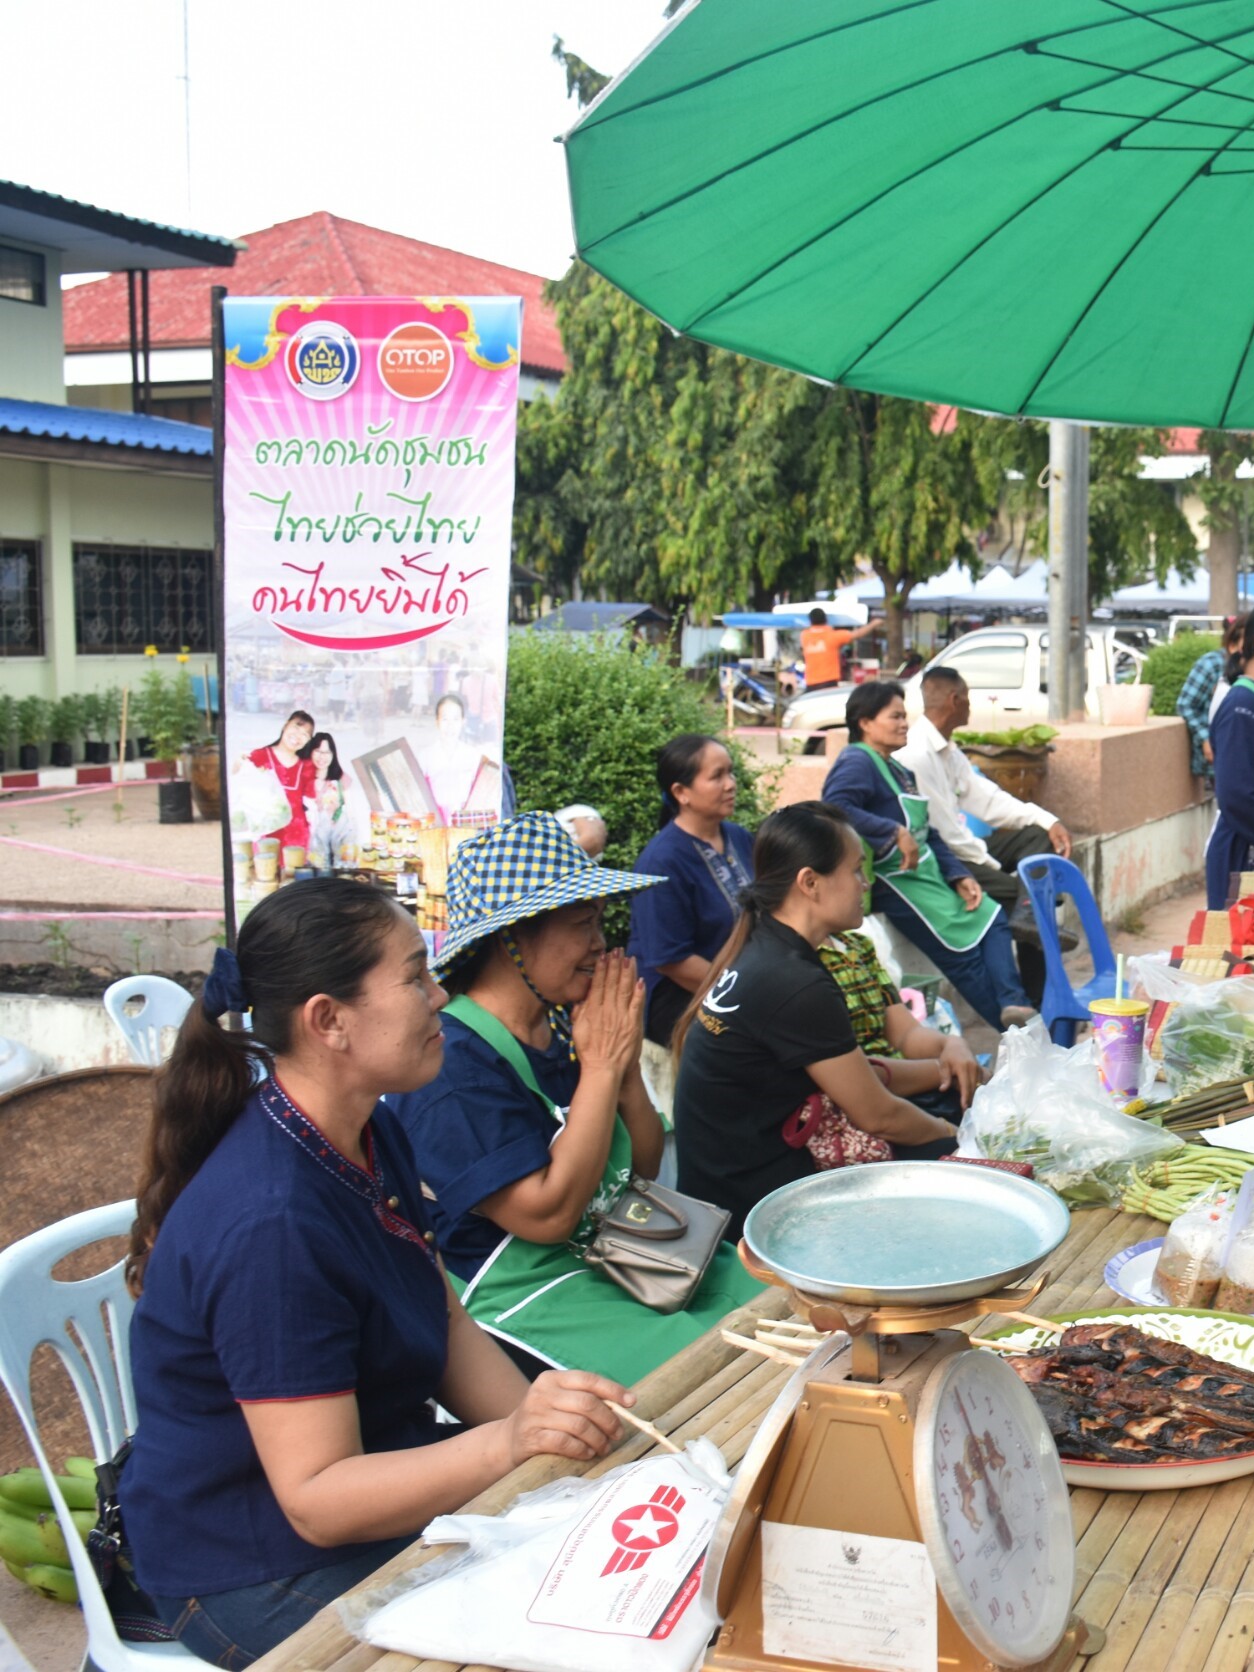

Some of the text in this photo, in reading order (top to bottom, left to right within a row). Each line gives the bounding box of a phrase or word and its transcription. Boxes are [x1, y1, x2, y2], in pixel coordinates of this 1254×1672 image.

[386, 349, 445, 366] OTOP
[255, 420, 488, 489] ตลาดนัดชุมชน
[249, 491, 480, 544] ไทยช่วยไทย
[252, 552, 490, 616] คนไทยยิ้มได้
